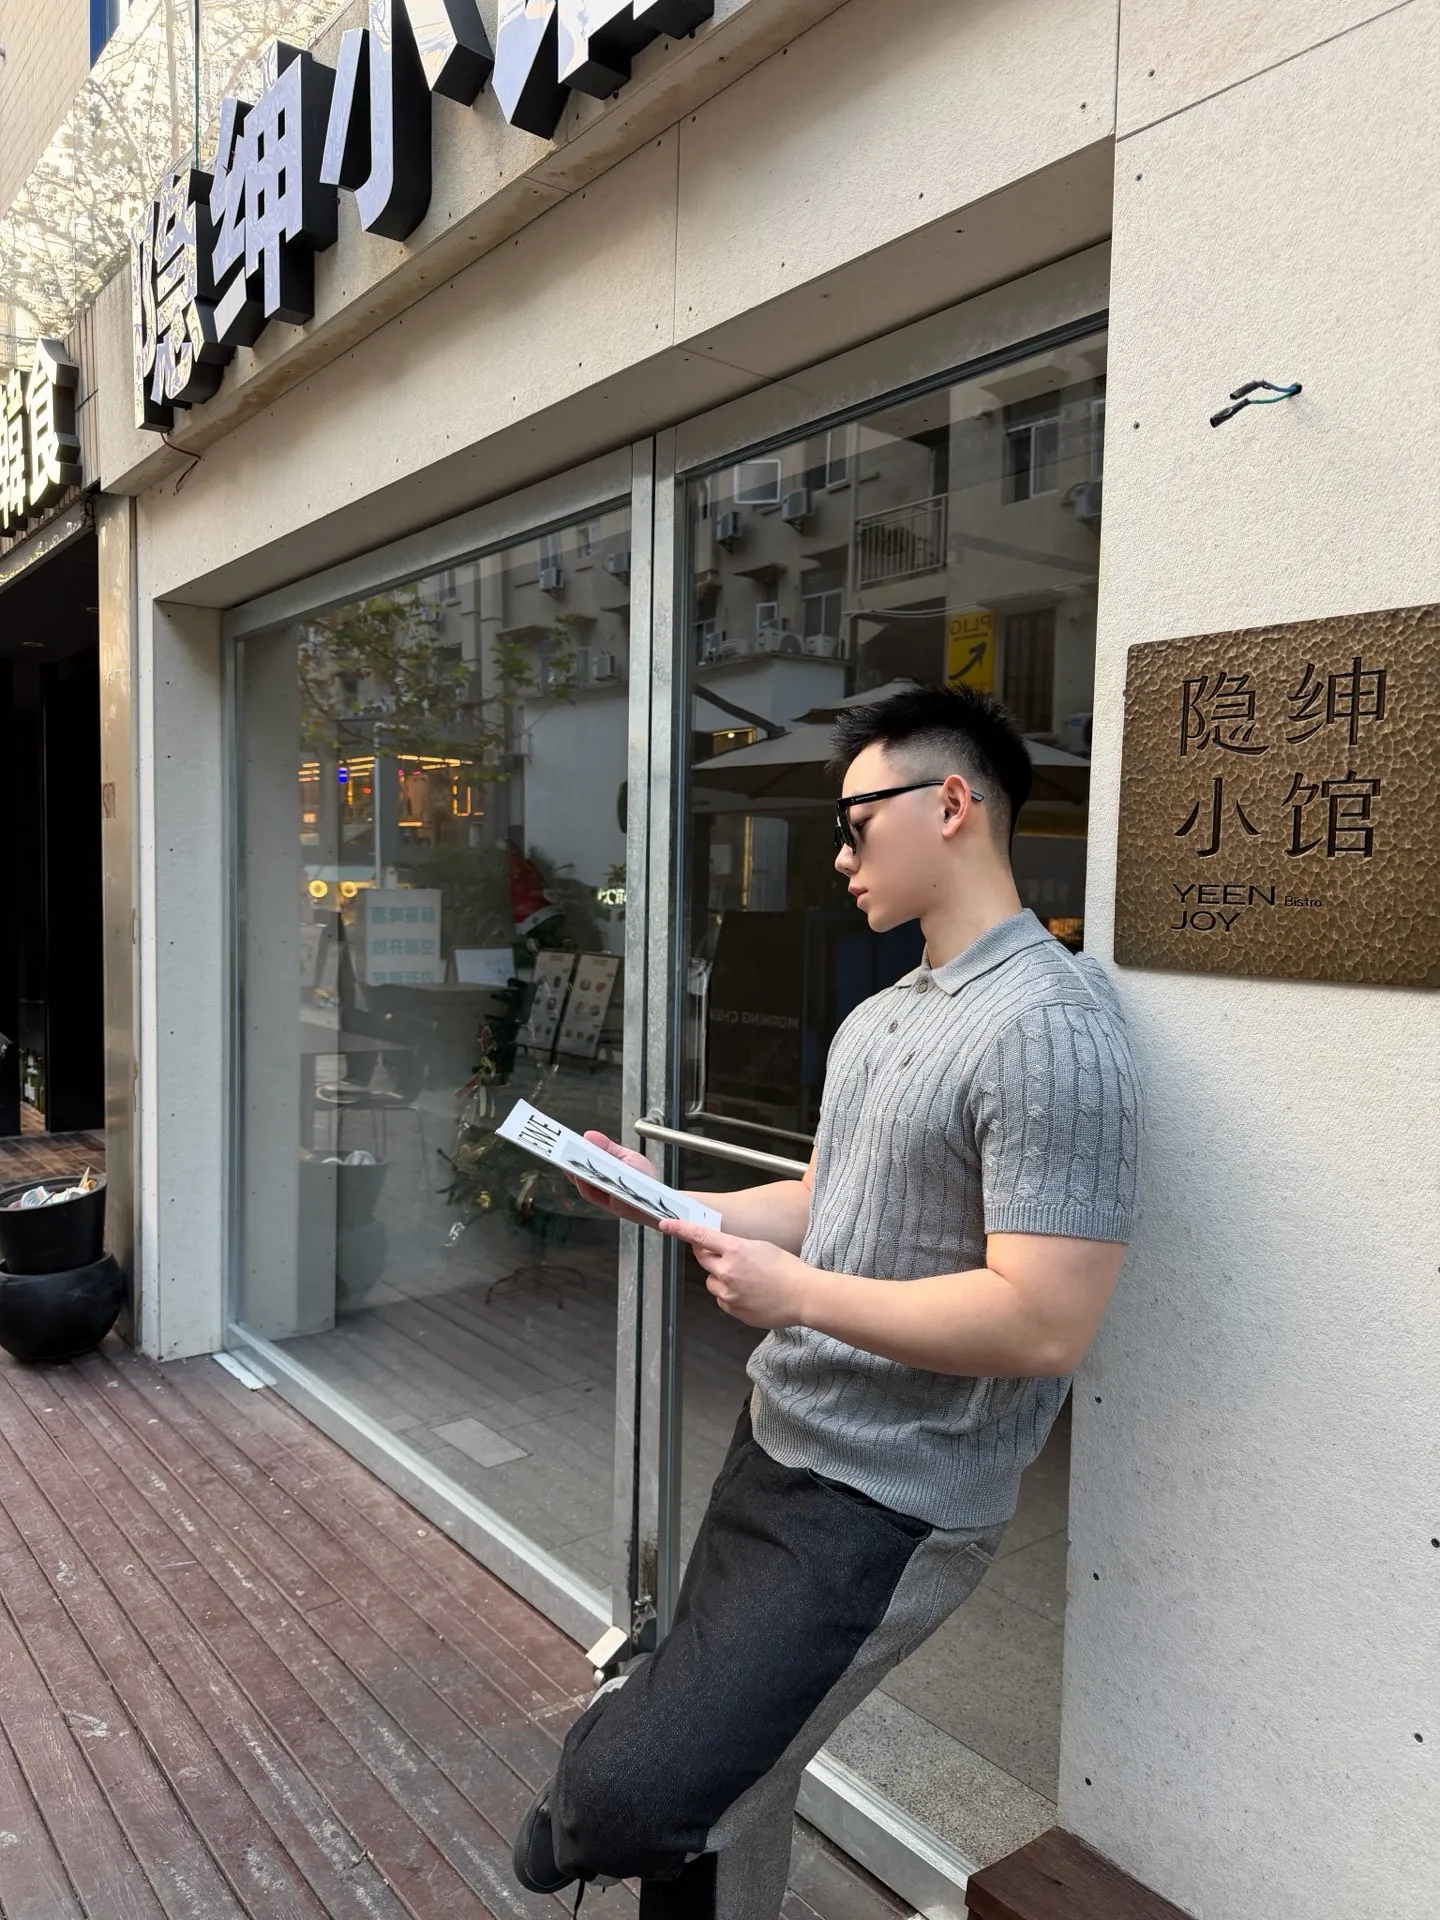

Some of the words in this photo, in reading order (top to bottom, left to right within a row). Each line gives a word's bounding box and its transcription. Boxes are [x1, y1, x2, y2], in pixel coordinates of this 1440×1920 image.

[1178, 656, 1388, 758] 隐绅
[1173, 770, 1382, 859] 小馆
[1170, 910, 1242, 933] JOY
[1171, 883, 1277, 907] YEEN
[1284, 894, 1323, 909] Bistro
